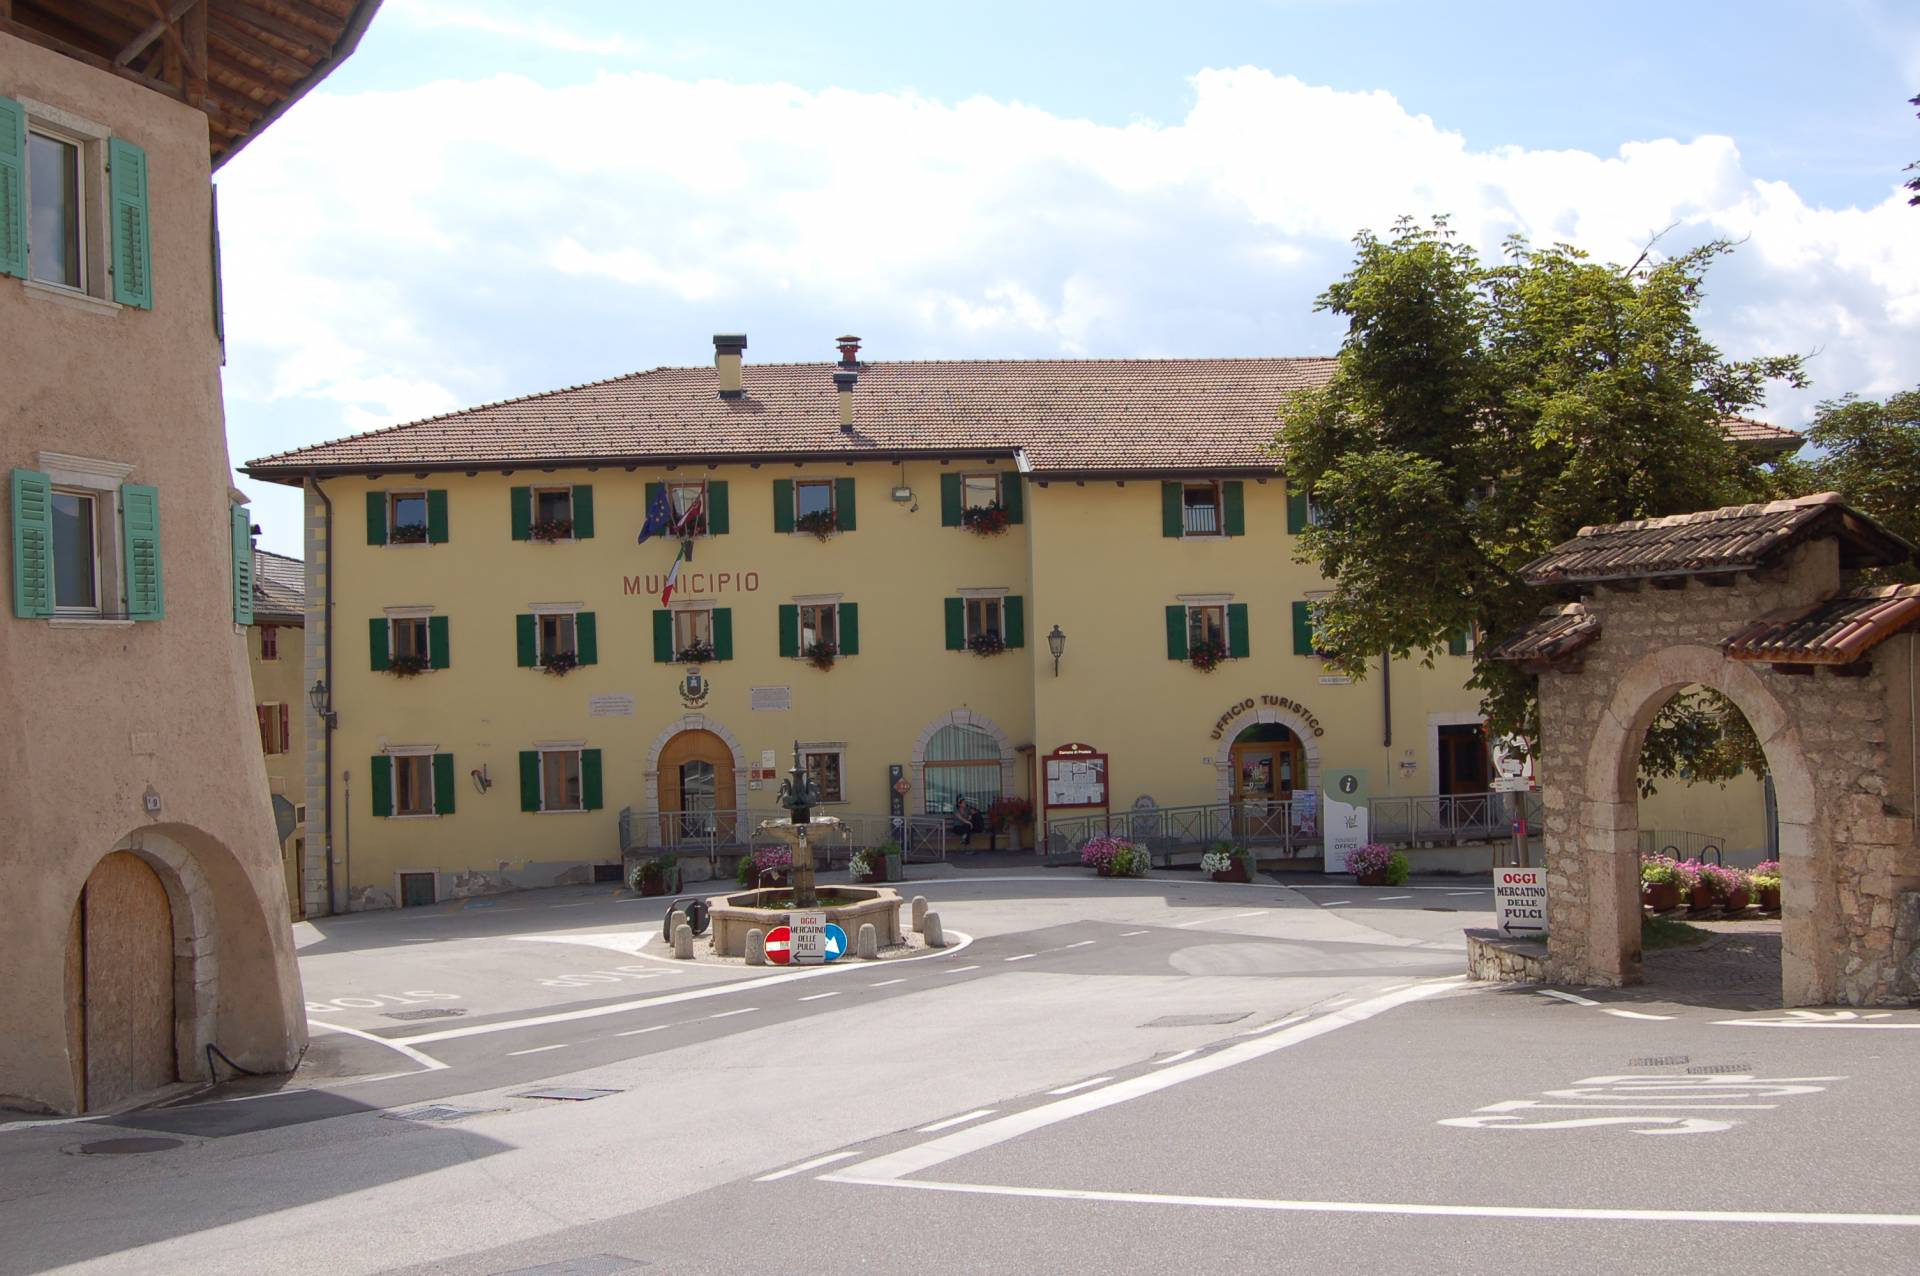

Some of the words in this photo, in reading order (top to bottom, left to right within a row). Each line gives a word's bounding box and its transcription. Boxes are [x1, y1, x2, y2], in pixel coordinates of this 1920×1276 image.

[1210, 698, 1255, 740] UFFICIO
[1261, 695, 1324, 737] TURISTICO
[1503, 873, 1537, 884] OGGI
[1496, 886, 1546, 897] MERCATINO
[1507, 899, 1538, 907] DELLE
[1504, 909, 1543, 919] PULCI
[800, 917, 817, 925] OGGI
[790, 926, 826, 934] MERCATINO
[798, 935, 816, 943] DELLE
[797, 943, 816, 951] PULCI
[535, 965, 685, 987] STOP
[1436, 1074, 1850, 1135] STOP
